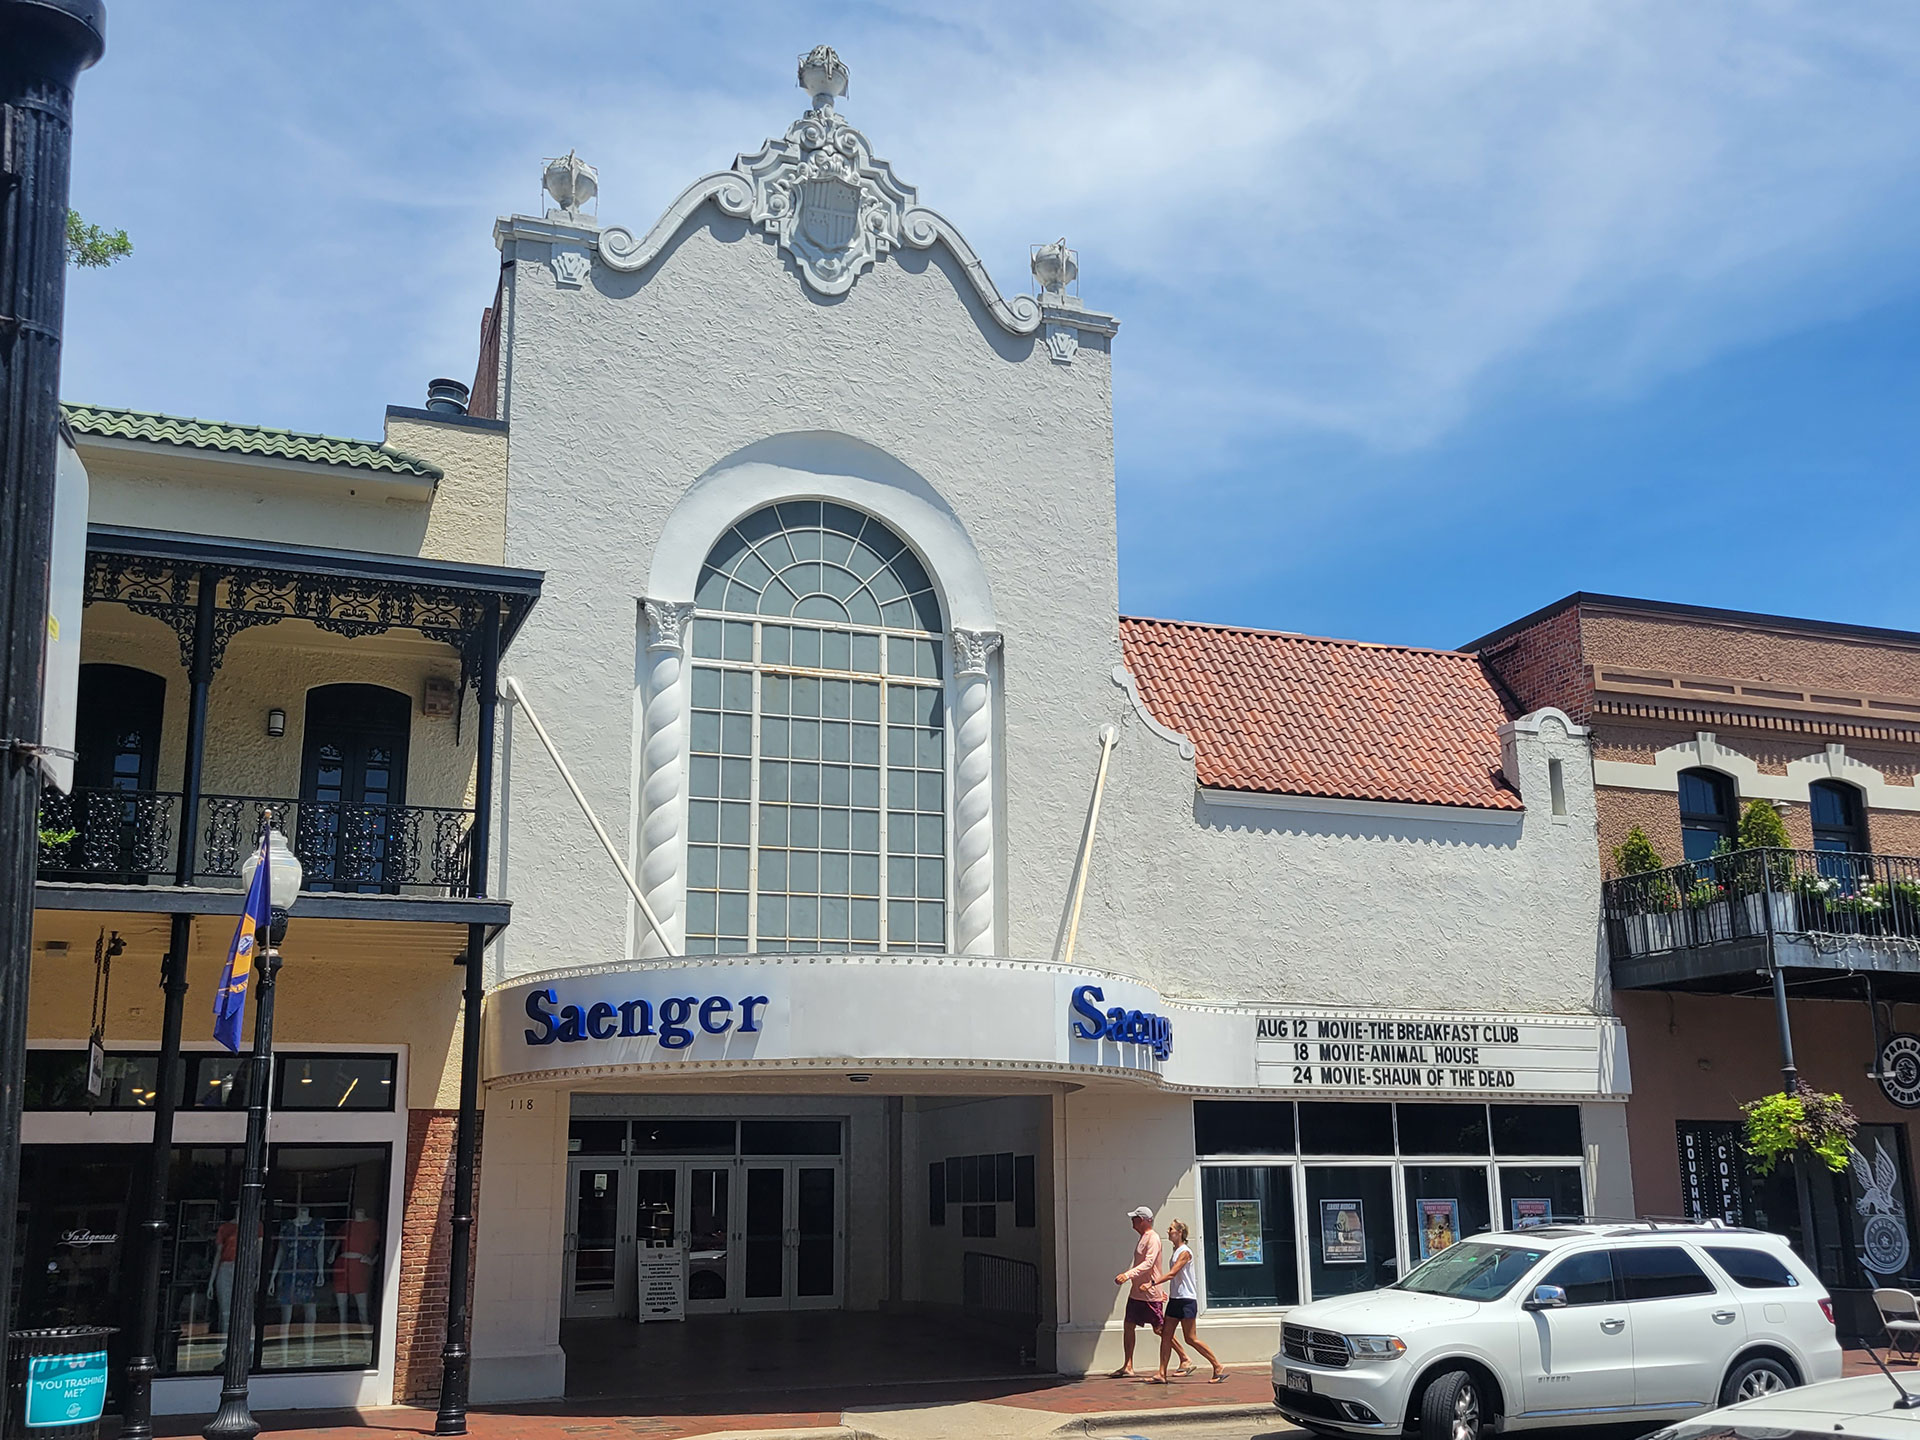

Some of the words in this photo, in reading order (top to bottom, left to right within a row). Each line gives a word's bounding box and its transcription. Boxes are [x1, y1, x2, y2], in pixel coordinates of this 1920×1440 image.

[525, 988, 769, 1049] Saenger
[1257, 1019, 1288, 1037] AUG
[1292, 1020, 1308, 1038] 12
[1318, 1021, 1394, 1040] MOVIE-THE
[1397, 1023, 1479, 1041] BREAKFAST
[1483, 1026, 1519, 1043] CLUB
[1294, 1043, 1309, 1061] 18
[1319, 1044, 1428, 1063] MOVIE-ANIMAL
[1435, 1046, 1479, 1064] HOUSE
[1293, 1066, 1312, 1084] 24
[1321, 1067, 1421, 1087] MOVIE-SHAUN
[1427, 1069, 1444, 1086] OF
[1450, 1069, 1475, 1087] THE
[1479, 1071, 1515, 1088] DEAD
[510, 1099, 534, 1110] 118
[64, 1374, 104, 1388] TRASHING
